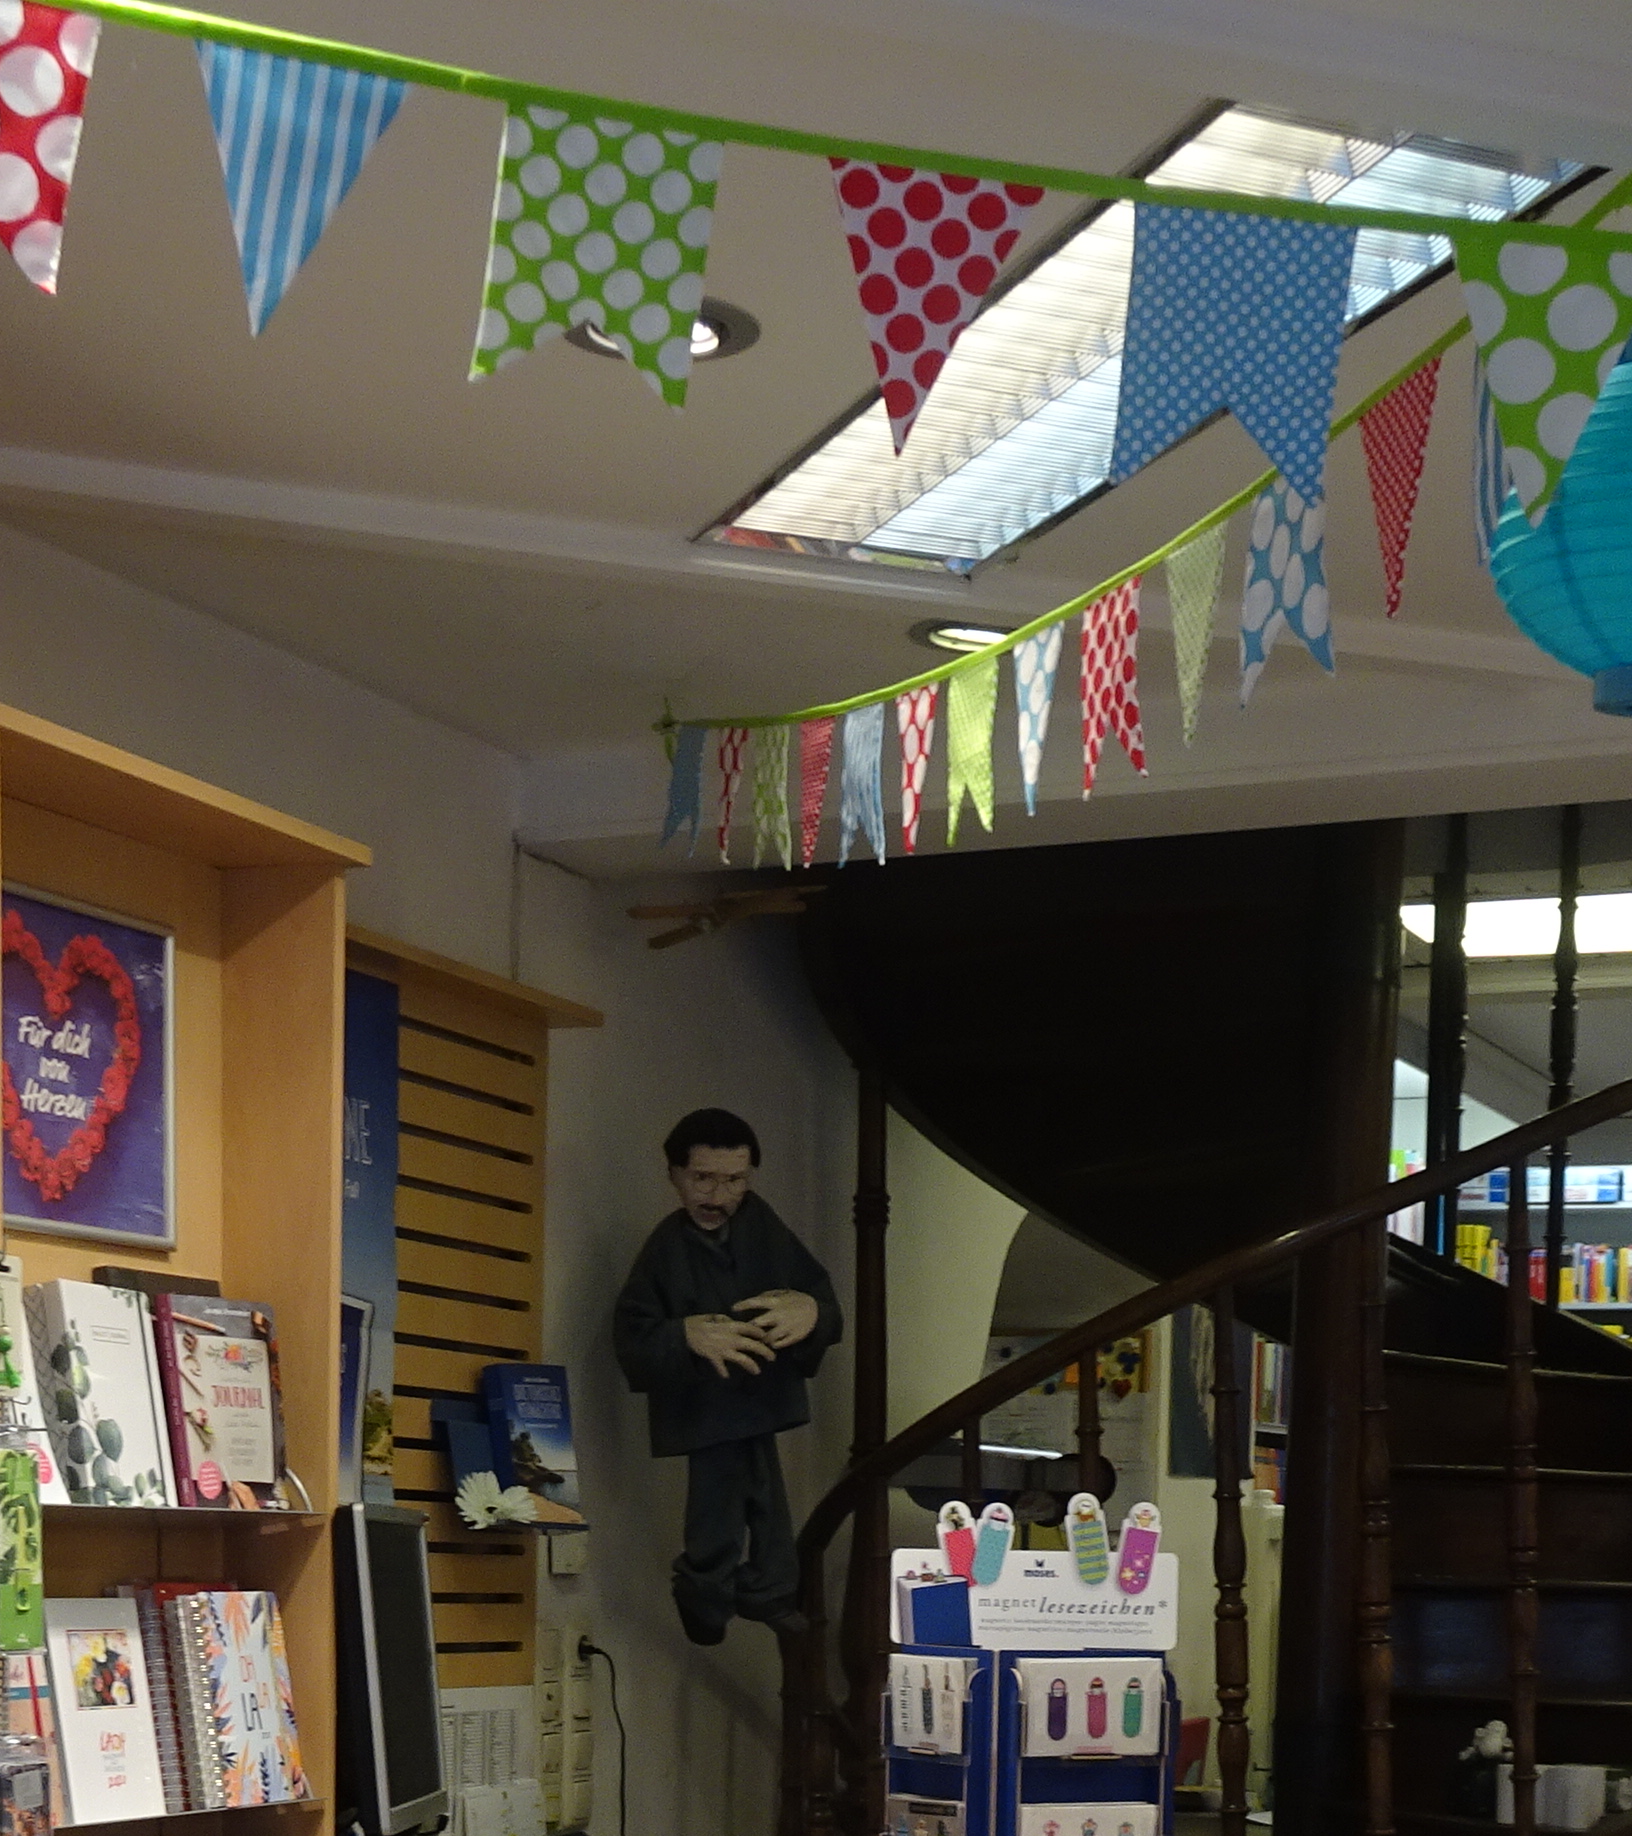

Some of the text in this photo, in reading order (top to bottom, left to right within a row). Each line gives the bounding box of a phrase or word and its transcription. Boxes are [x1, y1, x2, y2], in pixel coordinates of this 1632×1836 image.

[18, 1016, 91, 1059] Für dich
[20, 1077, 86, 1121] Herzen
